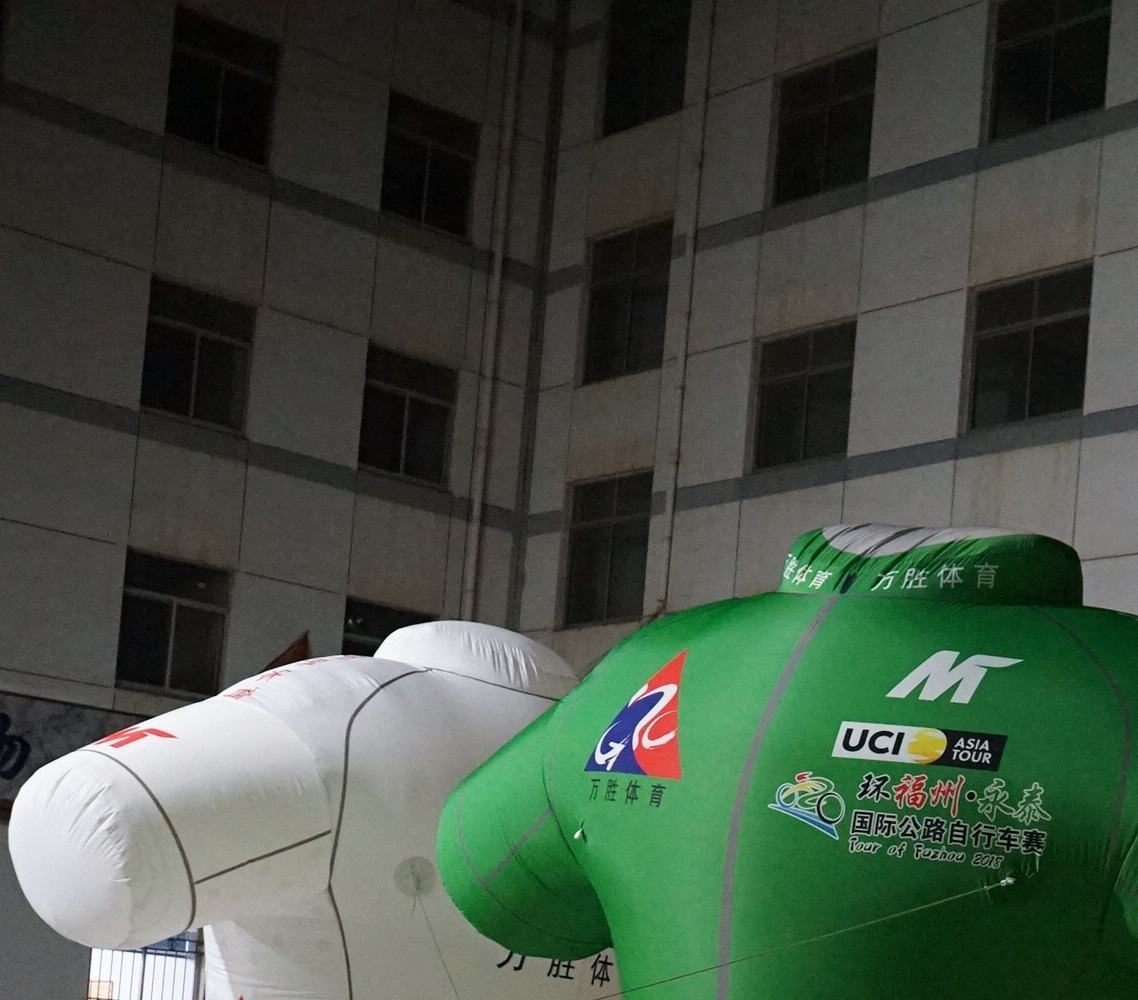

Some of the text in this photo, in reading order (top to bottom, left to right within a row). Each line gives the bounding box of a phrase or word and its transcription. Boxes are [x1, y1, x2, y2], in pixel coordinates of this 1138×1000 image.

[870, 562, 1001, 592] 万胜体育
[841, 727, 906, 756] UCI
[953, 736, 991, 752] ASIA
[950, 749, 993, 765] TOUR
[588, 777, 667, 809] 万胜体育
[850, 809, 1049, 856] 国际公路自行车赛
[848, 836, 1006, 870] Tour of Fuzhou 2018
